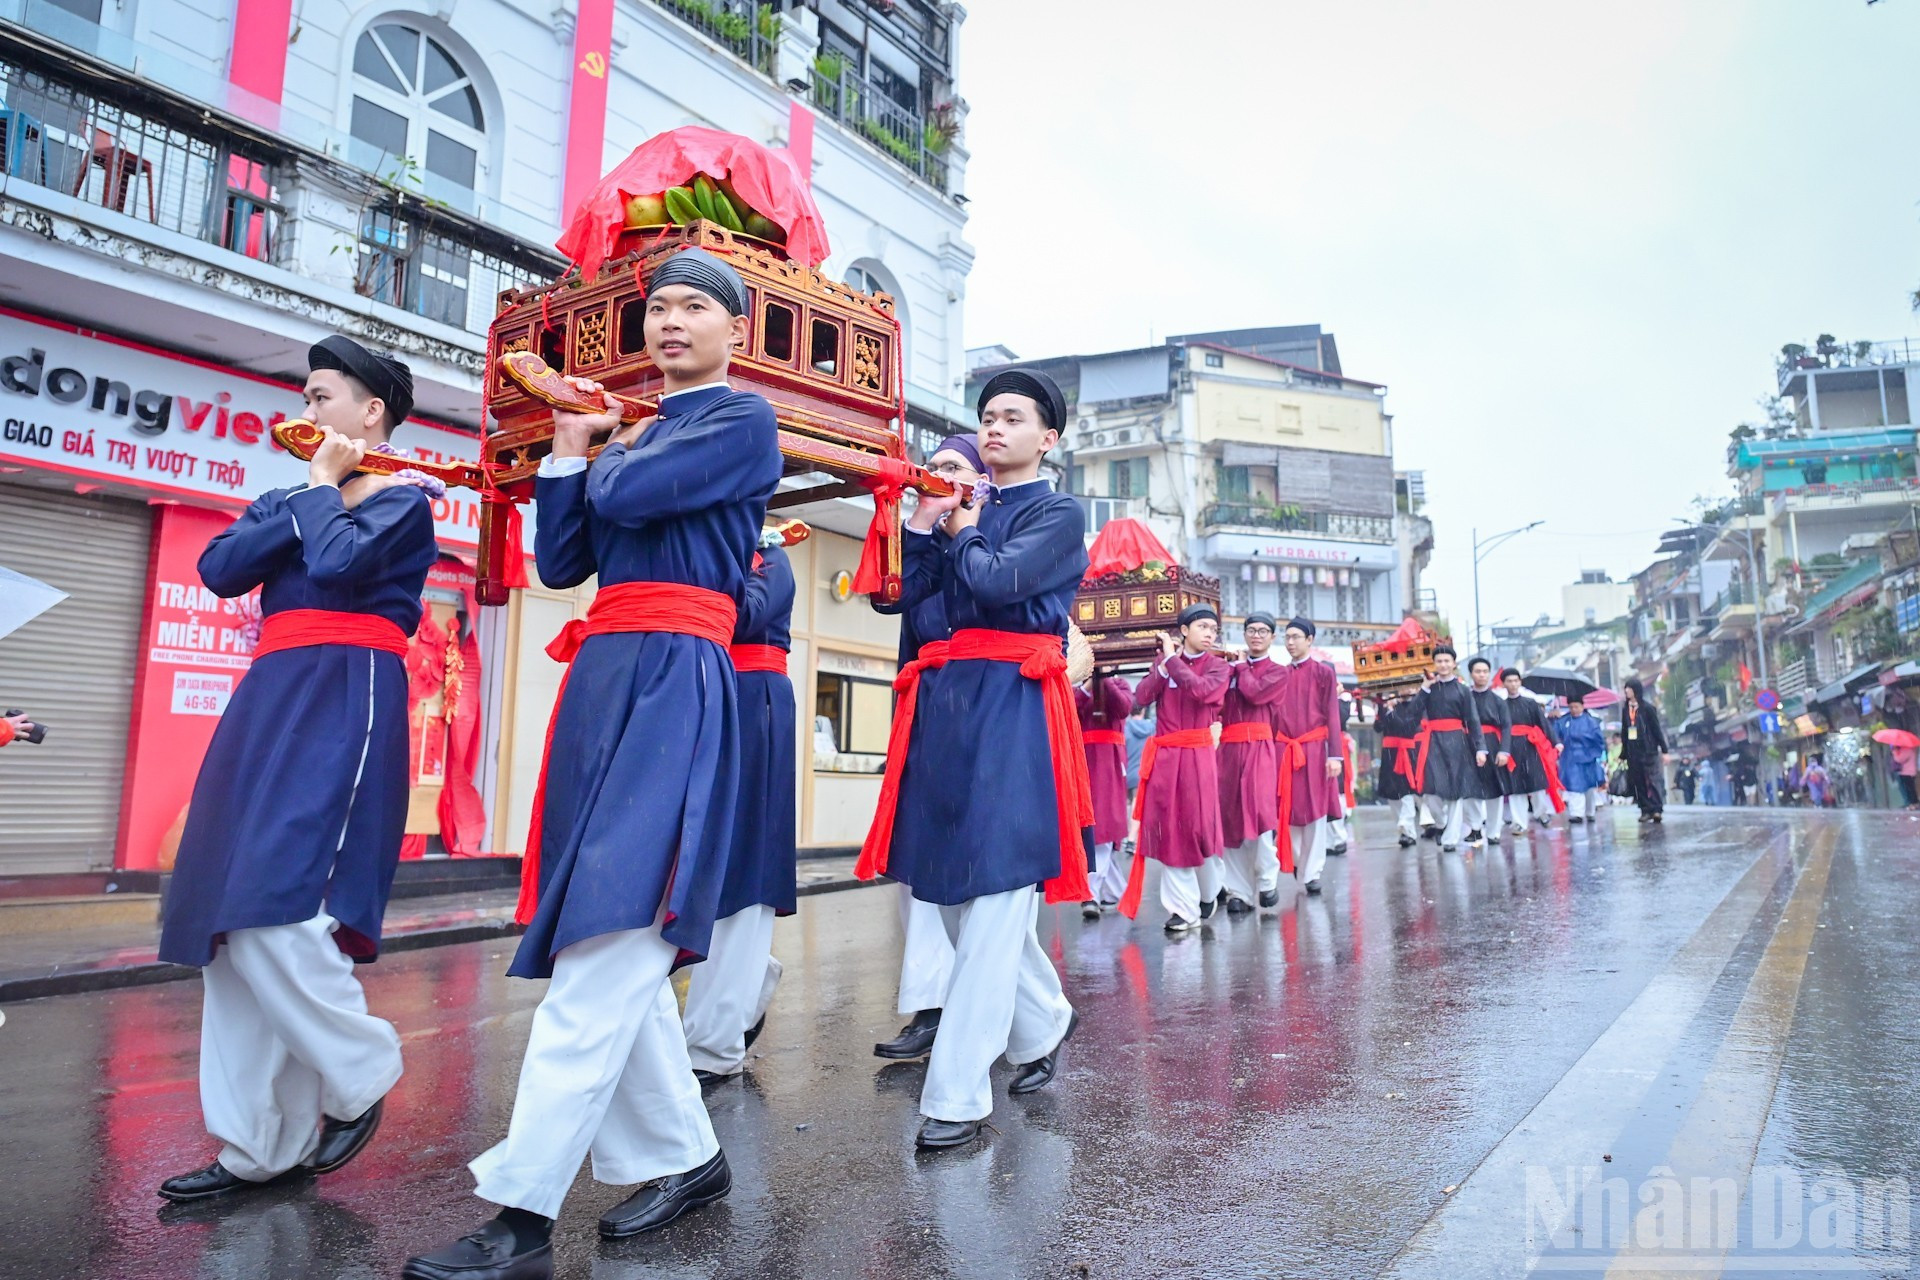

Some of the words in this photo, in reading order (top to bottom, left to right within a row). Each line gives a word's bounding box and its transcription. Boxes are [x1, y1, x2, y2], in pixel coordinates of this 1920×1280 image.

[4, 418, 53, 447] GIAO
[62, 428, 96, 458] GIÁ
[106, 439, 137, 470] TRỊ
[146, 447, 198, 478] VƯỢT
[206, 459, 245, 489] TRỘI
[1266, 546, 1348, 561] HERBALIST
[158, 582, 219, 615] TRẠM
[158, 616, 215, 650] MIỄN
[153, 651, 171, 660] FREE
[172, 653, 193, 662] PHONE
[196, 656, 229, 665] CHARGING
[184, 695, 217, 711] 4G-5G
